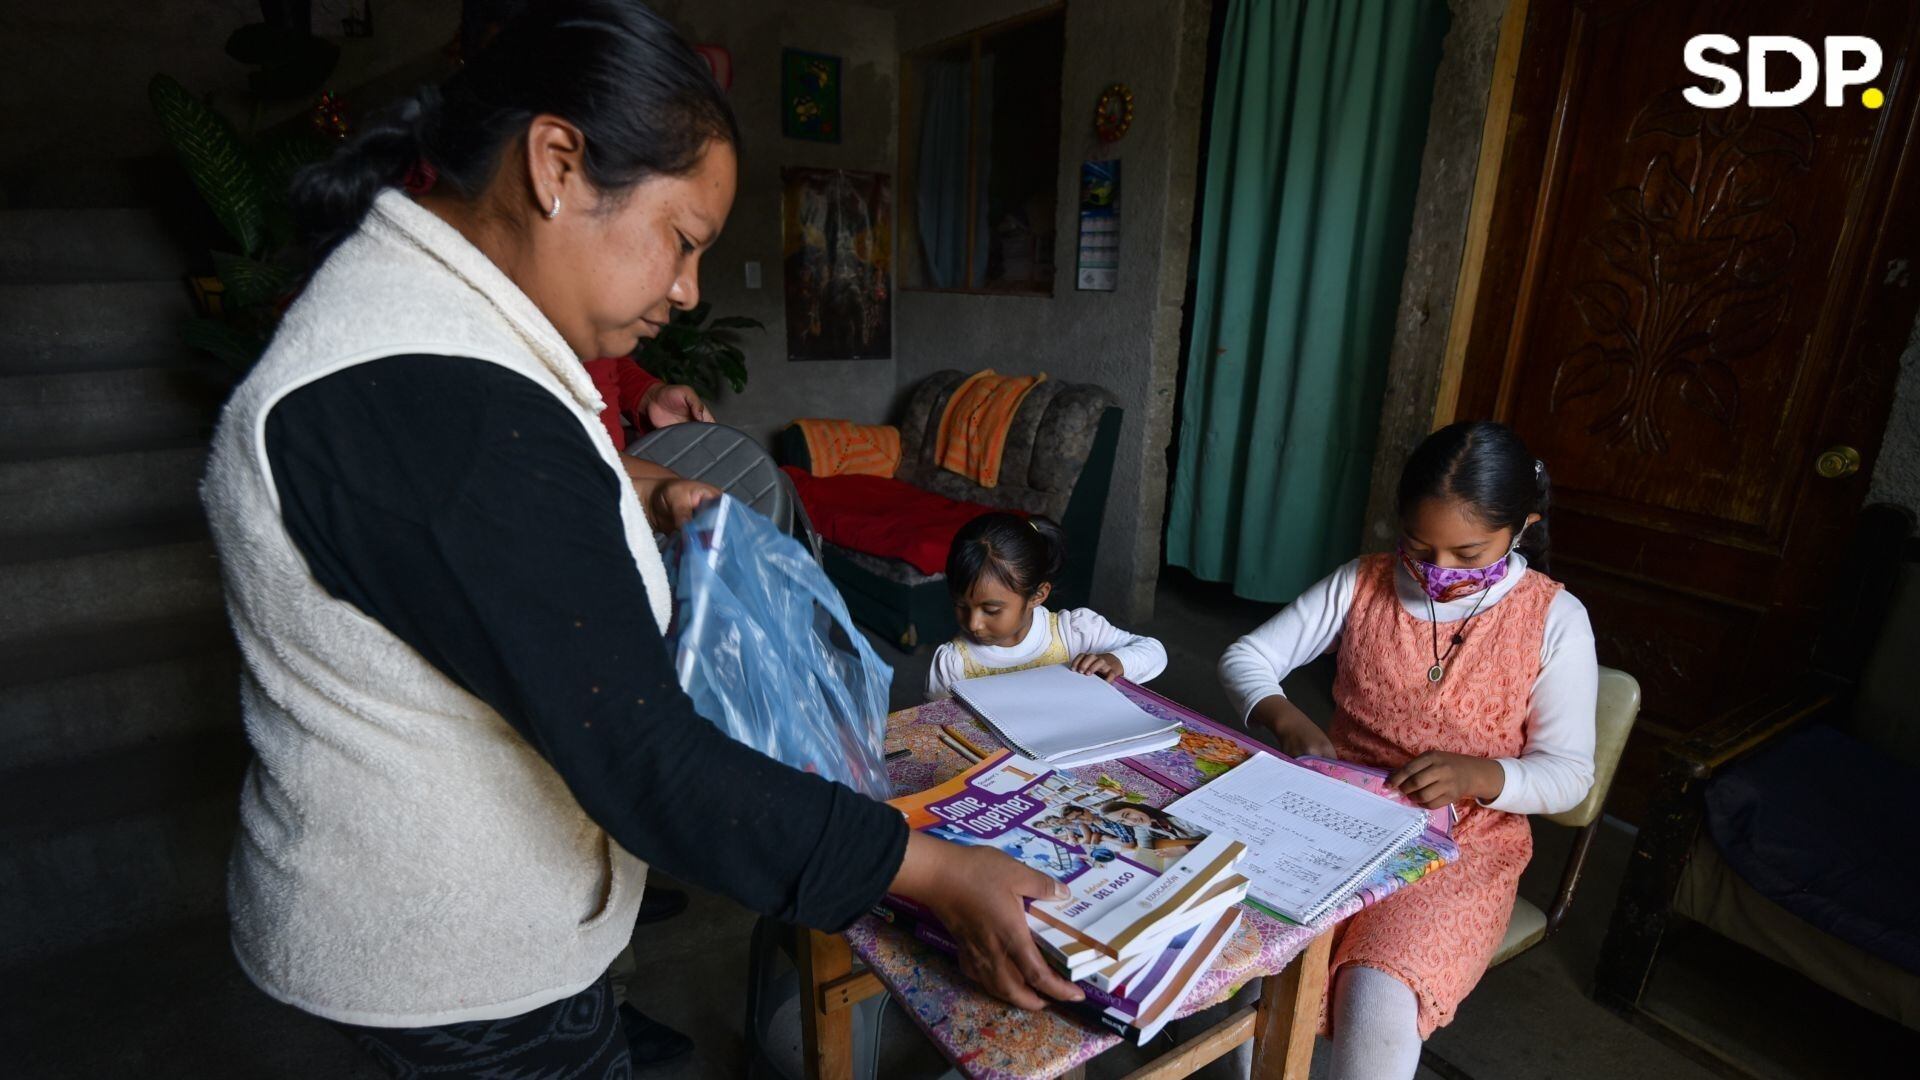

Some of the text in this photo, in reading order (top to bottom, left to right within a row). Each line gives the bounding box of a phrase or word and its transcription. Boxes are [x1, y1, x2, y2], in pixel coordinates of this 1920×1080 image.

[929, 796, 987, 821] Come
[955, 794, 1035, 835] Together
[1092, 871, 1136, 901] DEL PASO
[1063, 900, 1093, 918] LUNA
